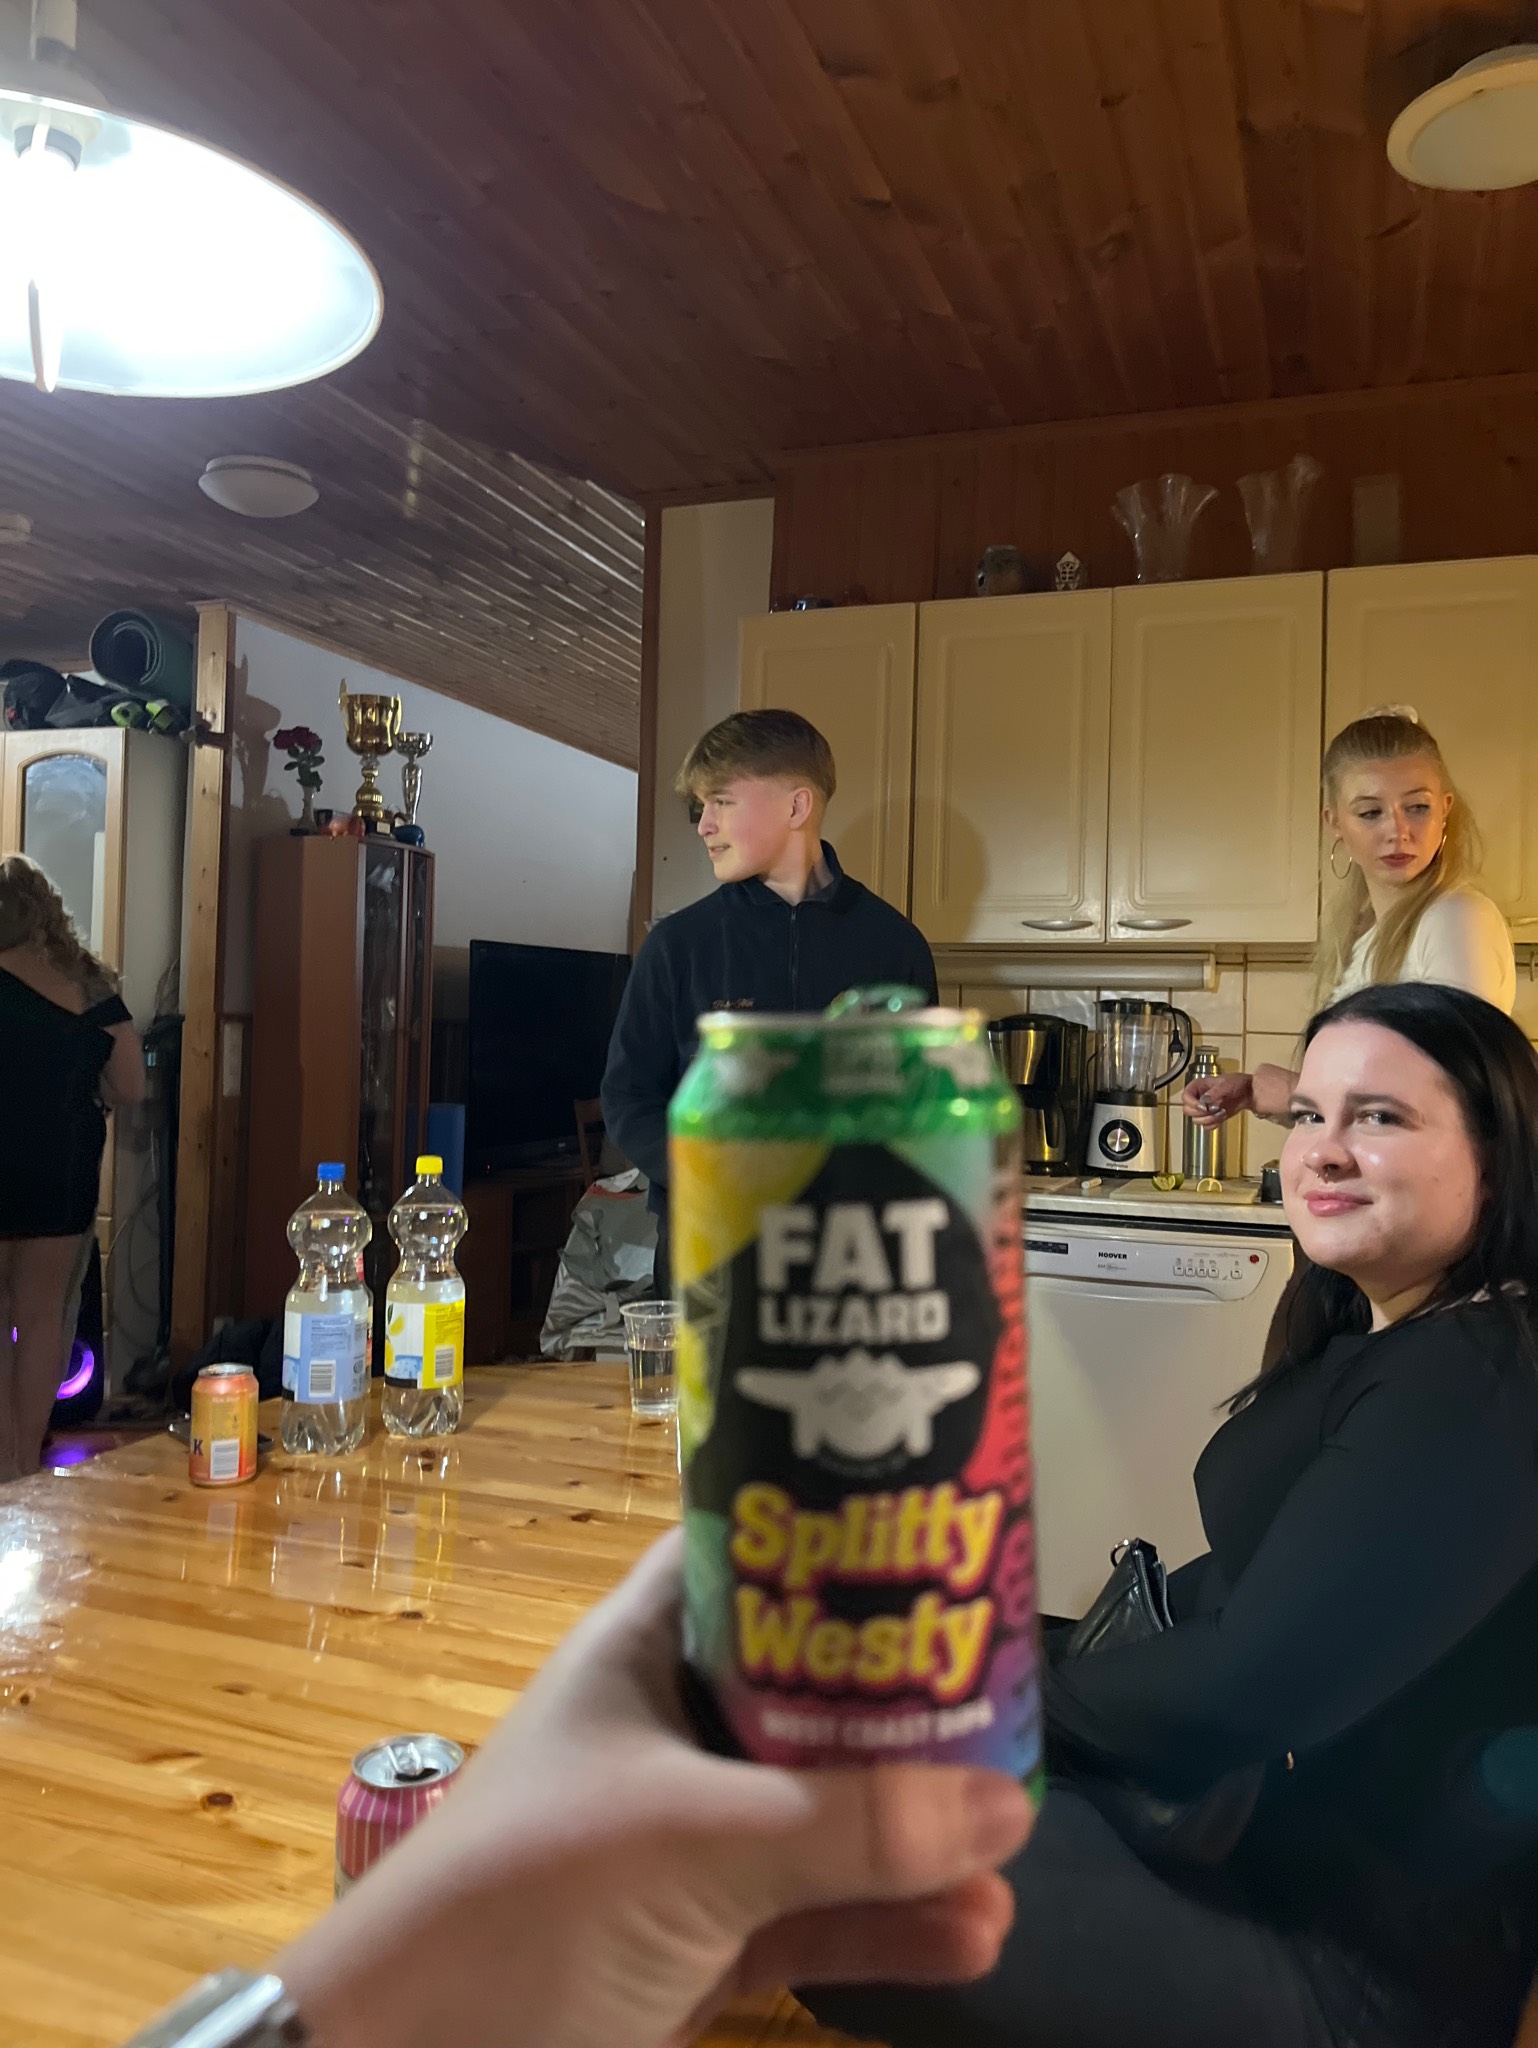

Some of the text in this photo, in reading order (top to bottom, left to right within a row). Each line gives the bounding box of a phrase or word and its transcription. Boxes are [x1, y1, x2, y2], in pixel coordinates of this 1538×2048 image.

[757, 1201, 951, 1292] FAT
[1098, 1251, 1128, 1260] HOOVER
[759, 1291, 951, 1345] LIZARD
[732, 1482, 1002, 1592] Splitty
[734, 1584, 994, 1695] Westy
